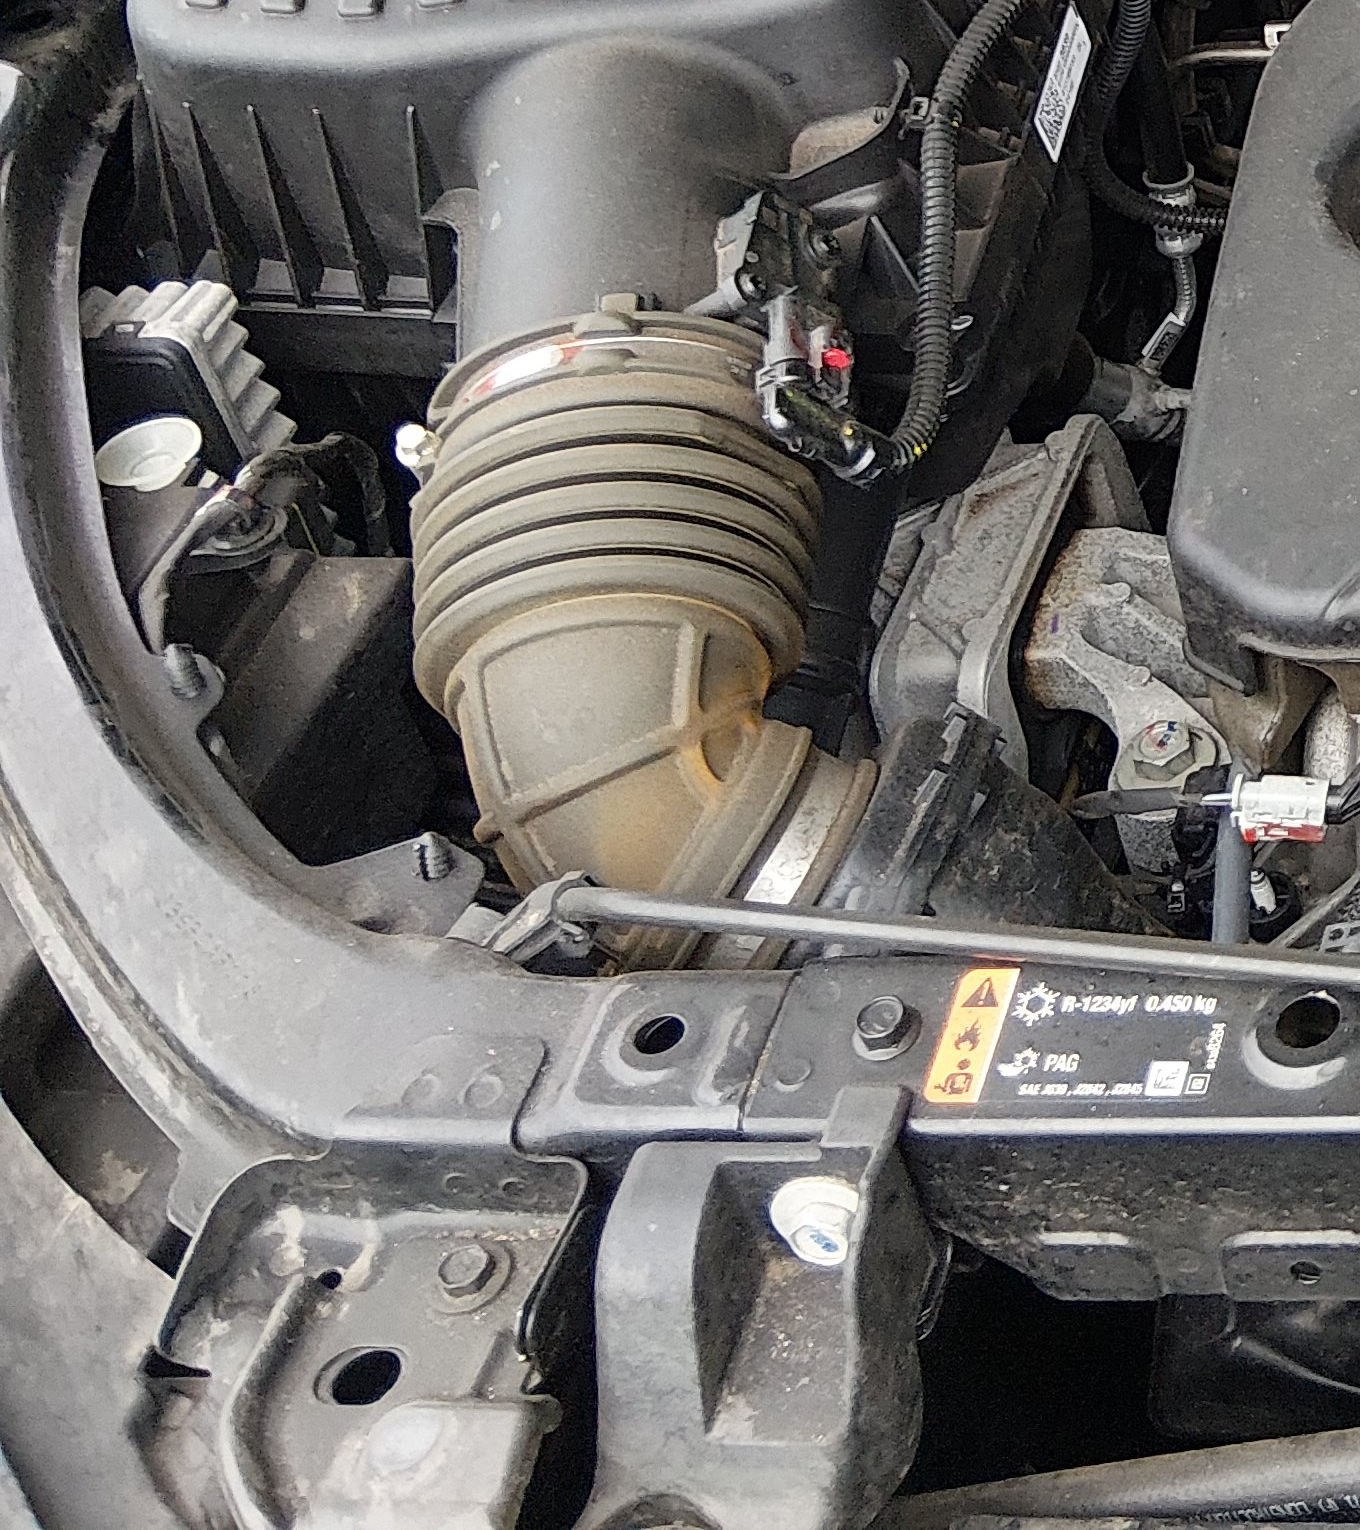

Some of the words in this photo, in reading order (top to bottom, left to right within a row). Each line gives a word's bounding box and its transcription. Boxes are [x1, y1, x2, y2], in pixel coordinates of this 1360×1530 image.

[1061, 994, 1139, 1015] R-1234yf
[1193, 994, 1218, 1015] kg
[1044, 1053, 1081, 1072] PAG
